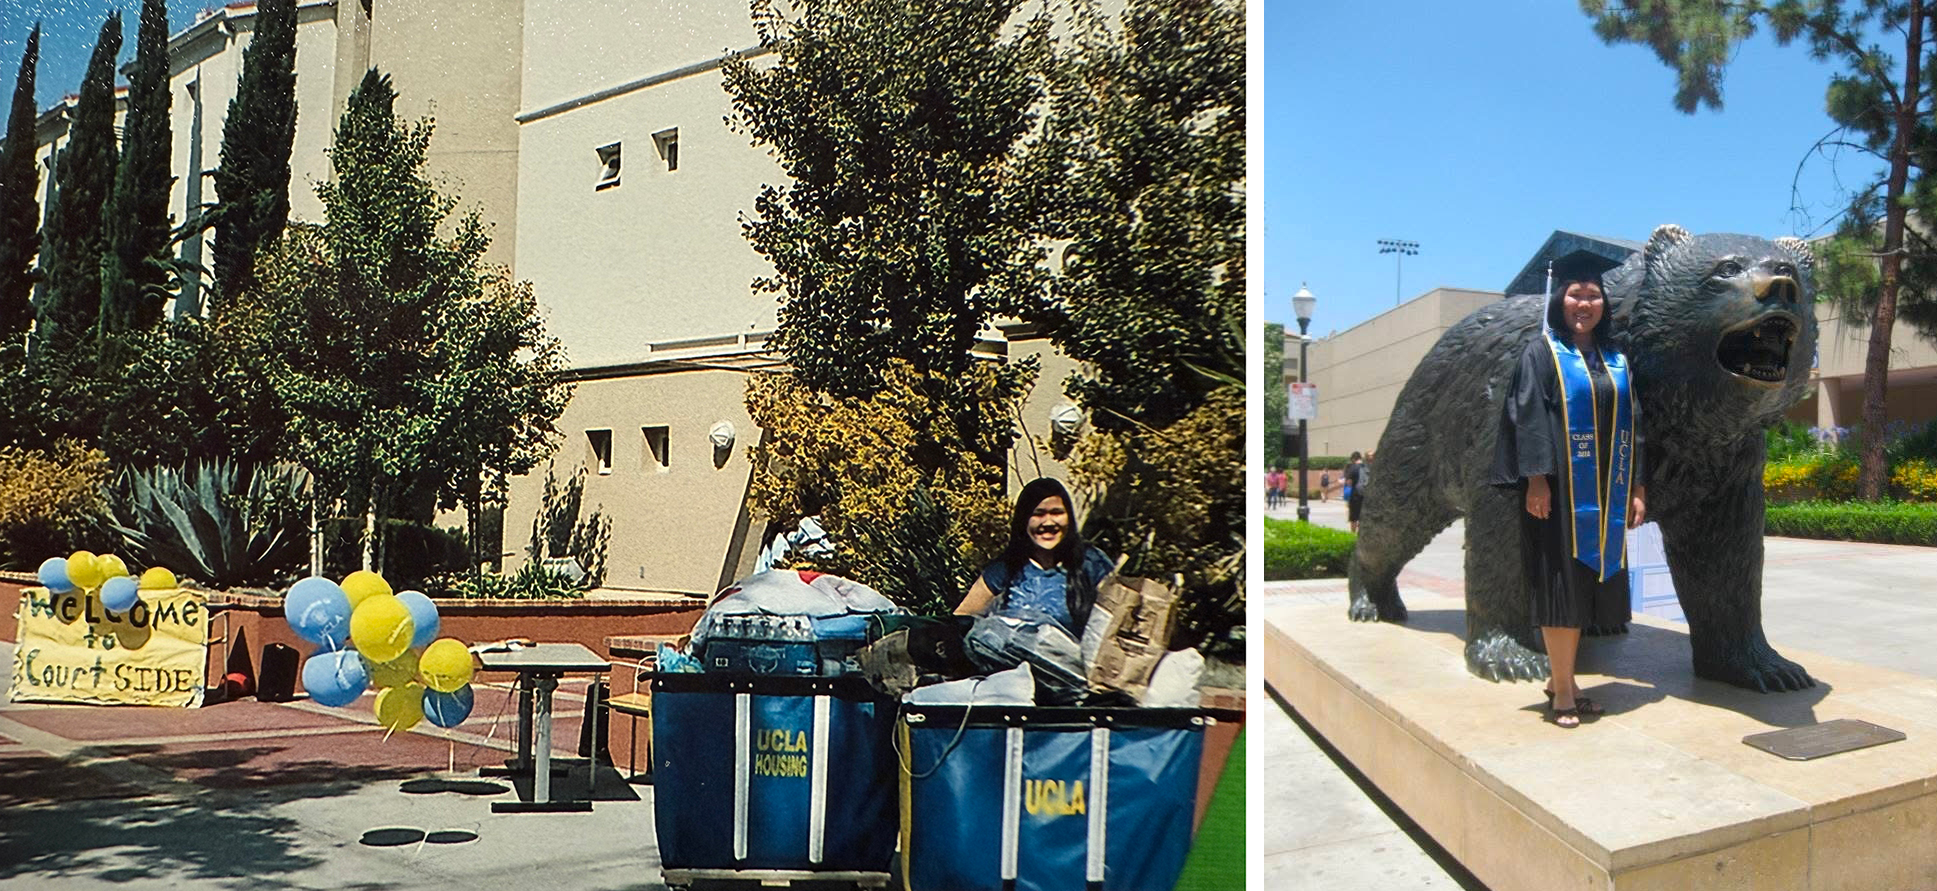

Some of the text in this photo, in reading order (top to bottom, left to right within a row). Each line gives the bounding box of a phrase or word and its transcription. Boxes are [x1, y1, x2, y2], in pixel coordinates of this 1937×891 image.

[1572, 433, 1594, 441] CLASS
[1615, 429, 1629, 485] UCLA
[83, 626, 115, 650] to
[26, 649, 192, 693] Court SIDE
[757, 729, 808, 752] UCLA
[755, 754, 808, 777] HOUSING
[1025, 779, 1086, 816] UCLA
